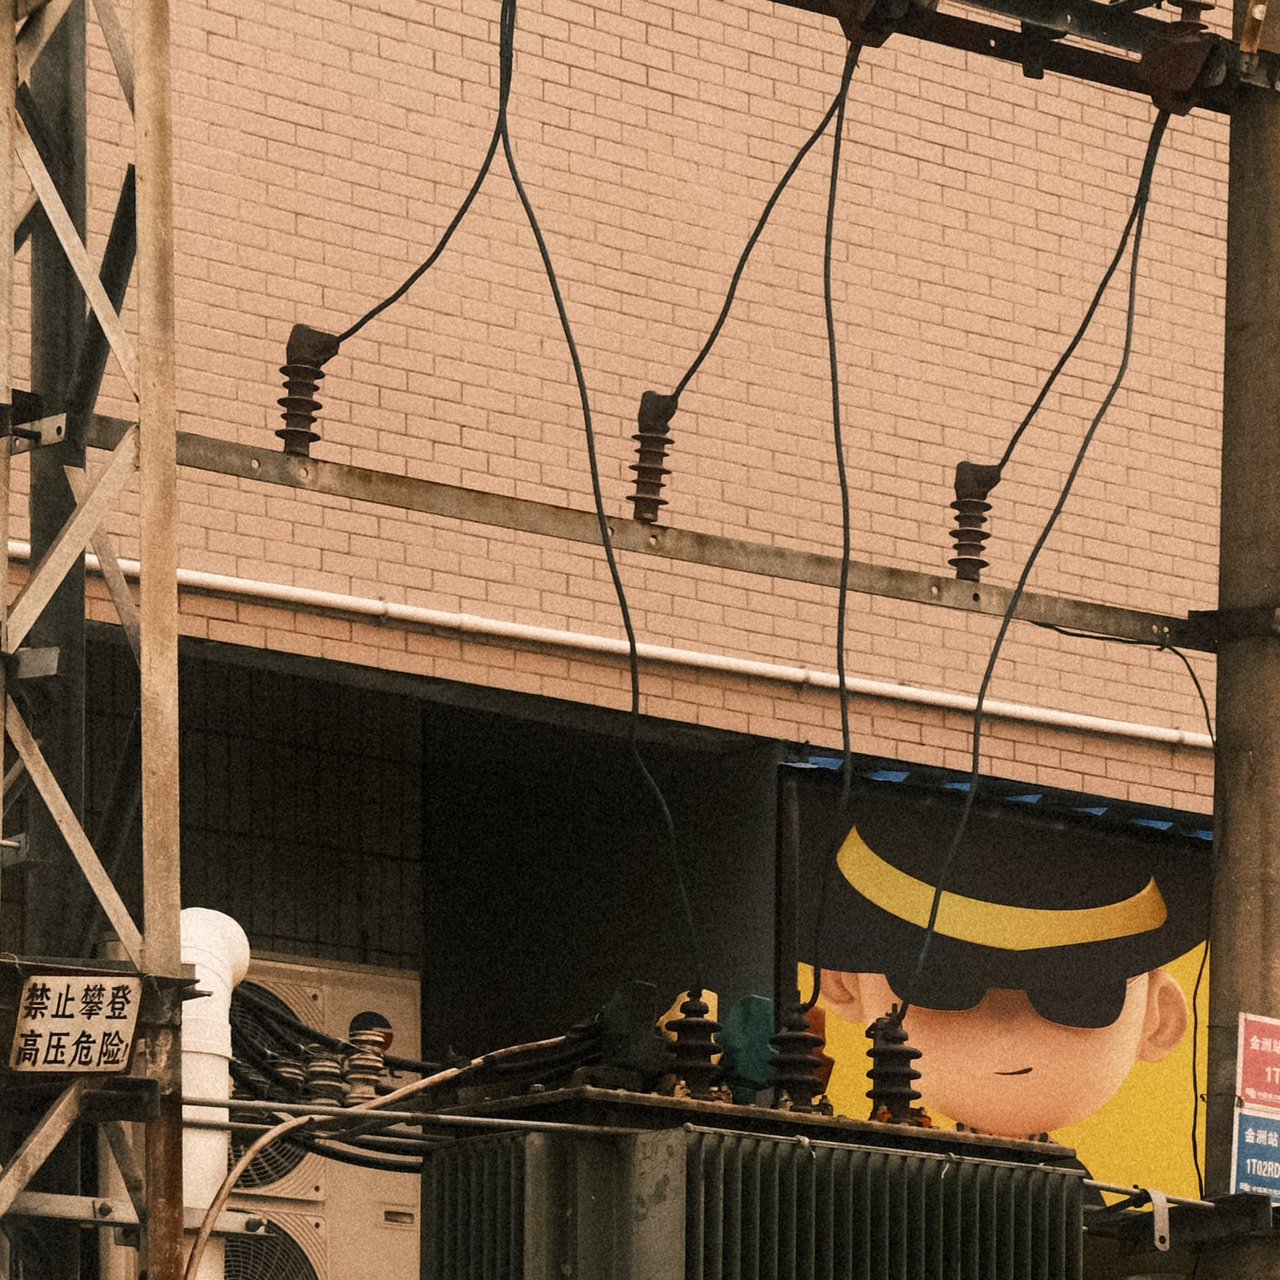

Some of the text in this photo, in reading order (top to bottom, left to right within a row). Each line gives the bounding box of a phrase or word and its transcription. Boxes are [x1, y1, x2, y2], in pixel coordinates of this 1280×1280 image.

[23, 982, 131, 1021] 禁止攀登
[15, 1029, 130, 1067] 高压危险！
[1244, 1127, 1279, 1148] 金洲站
